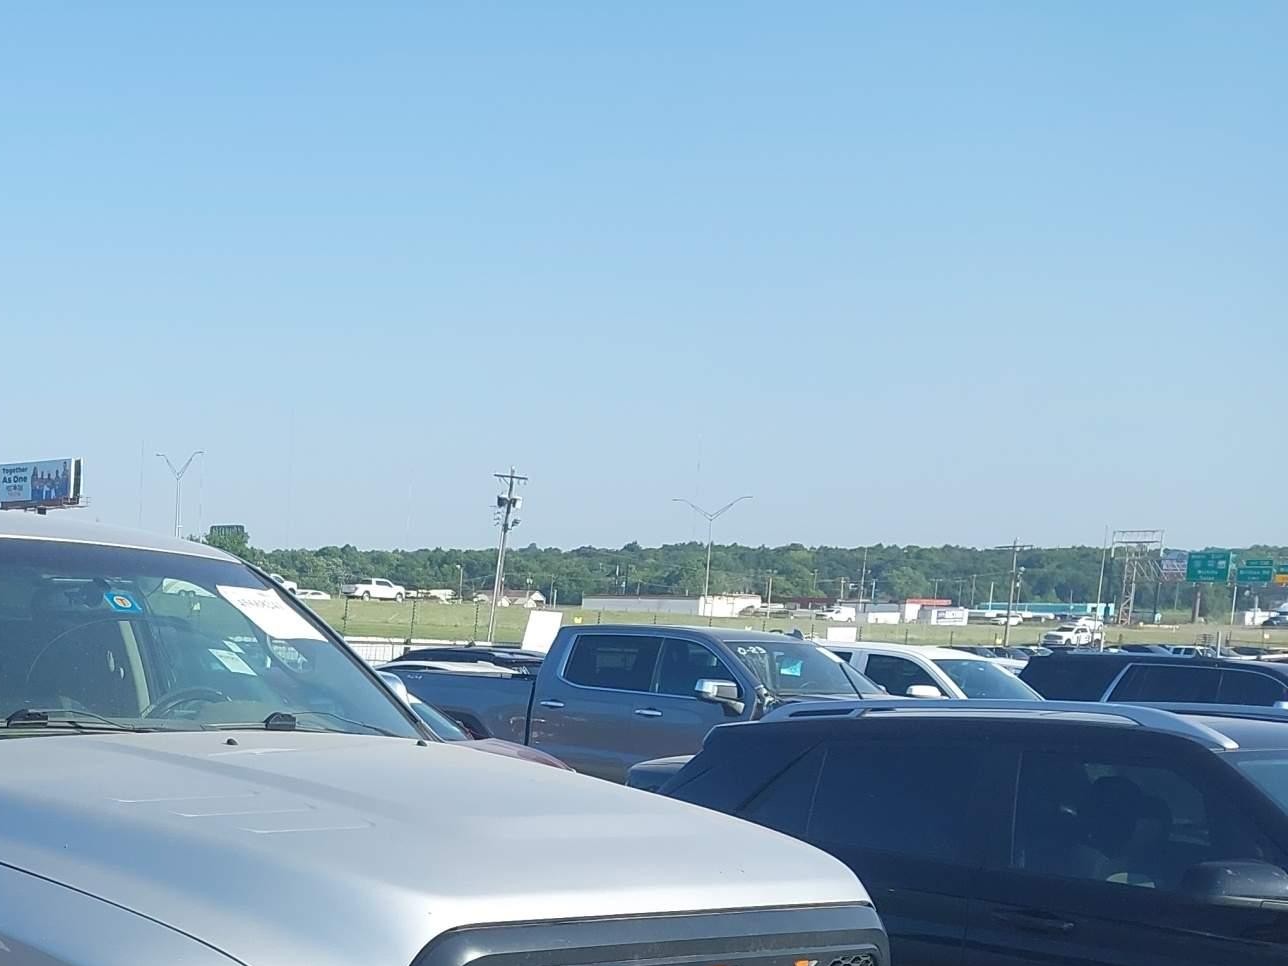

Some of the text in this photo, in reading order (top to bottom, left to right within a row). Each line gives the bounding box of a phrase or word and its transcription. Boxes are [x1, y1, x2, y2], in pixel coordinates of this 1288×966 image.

[2, 466, 28, 475] Together
[2, 475, 28, 484] As One
